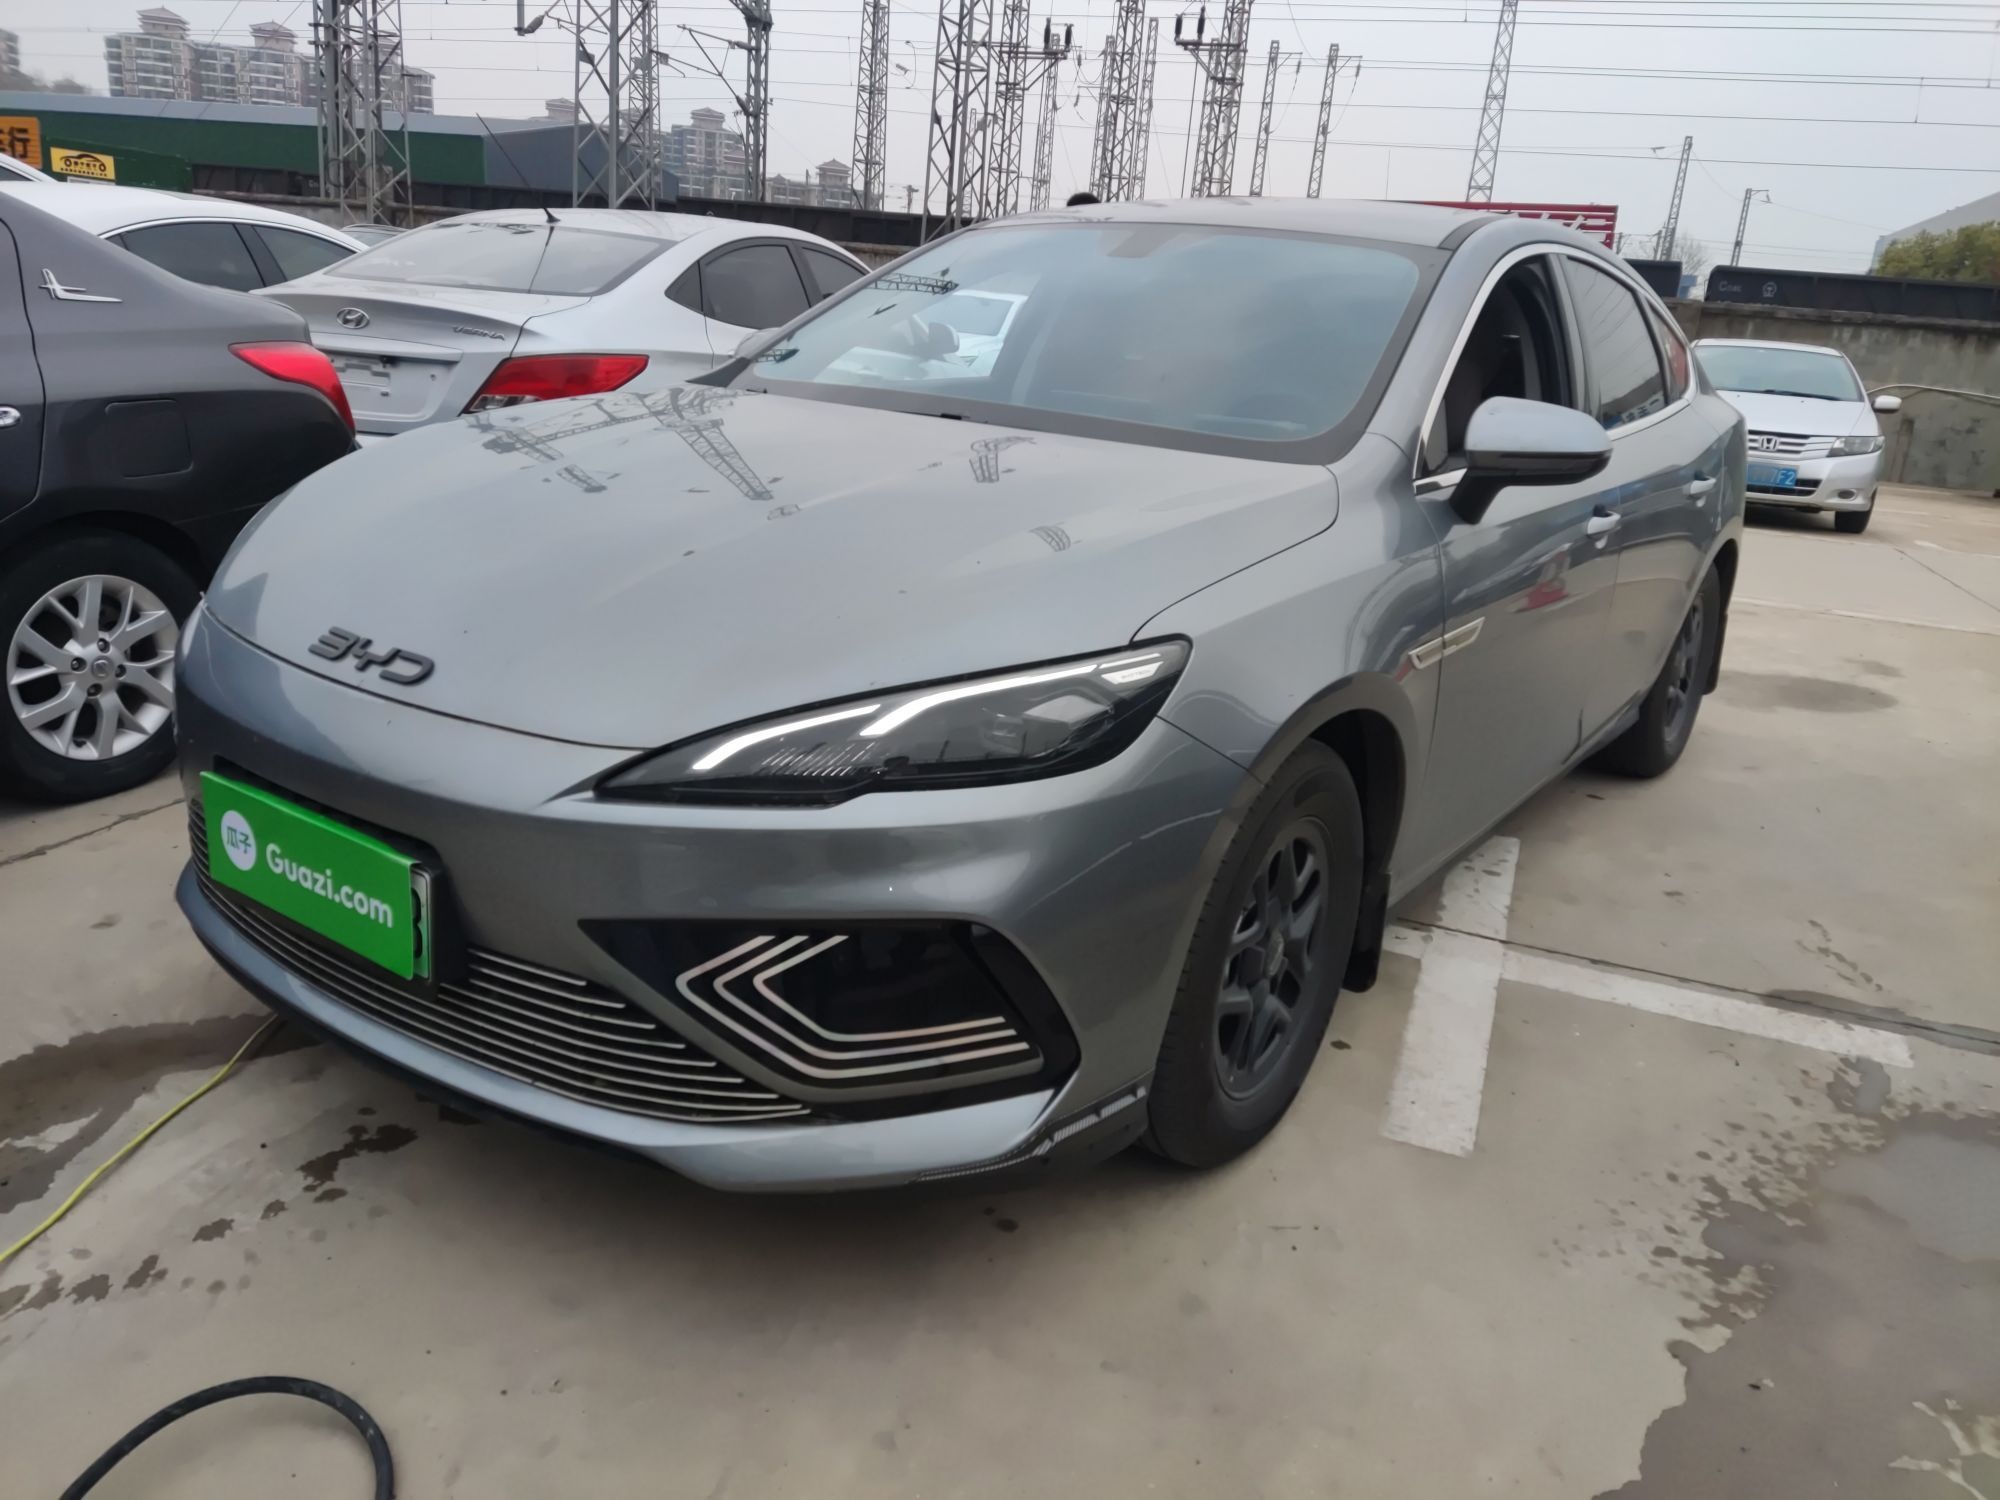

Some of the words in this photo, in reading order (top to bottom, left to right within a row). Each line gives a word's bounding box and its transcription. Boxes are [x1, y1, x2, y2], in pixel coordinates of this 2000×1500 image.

[452, 324, 505, 341] VERNA
[307, 625, 435, 686] BYD
[226, 826, 252, 854] 瓜子
[266, 843, 394, 928] Guazi.com
